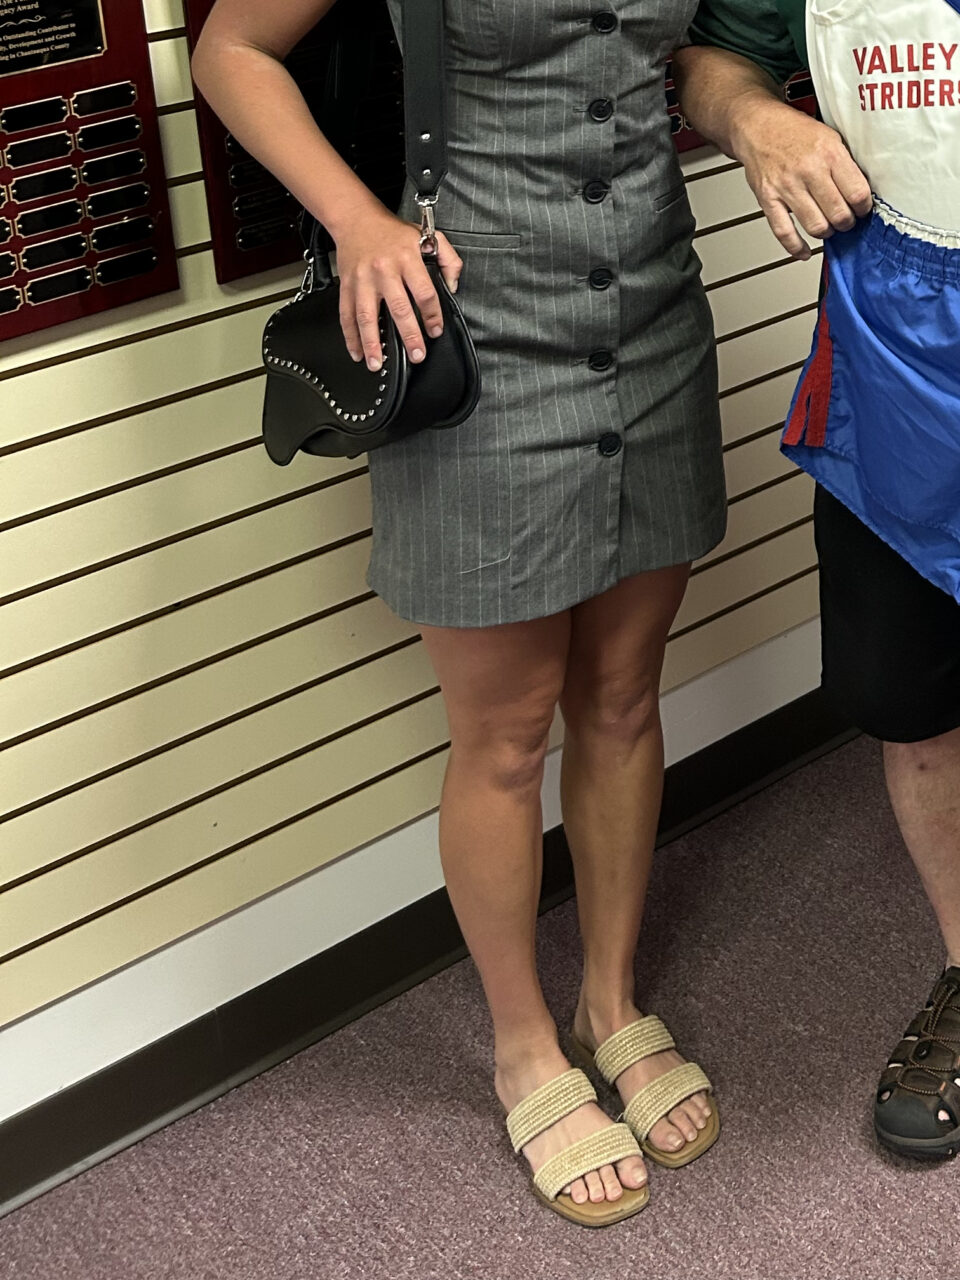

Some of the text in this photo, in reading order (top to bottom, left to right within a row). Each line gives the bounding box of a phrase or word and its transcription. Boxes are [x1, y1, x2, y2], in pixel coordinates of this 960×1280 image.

[17, 2, 39, 11] Award
[3, 31, 37, 40] Outstanding
[8, 39, 44, 49] Development
[16, 47, 50, 57] Chautauqua
[852, 42, 959, 76] VALLEY
